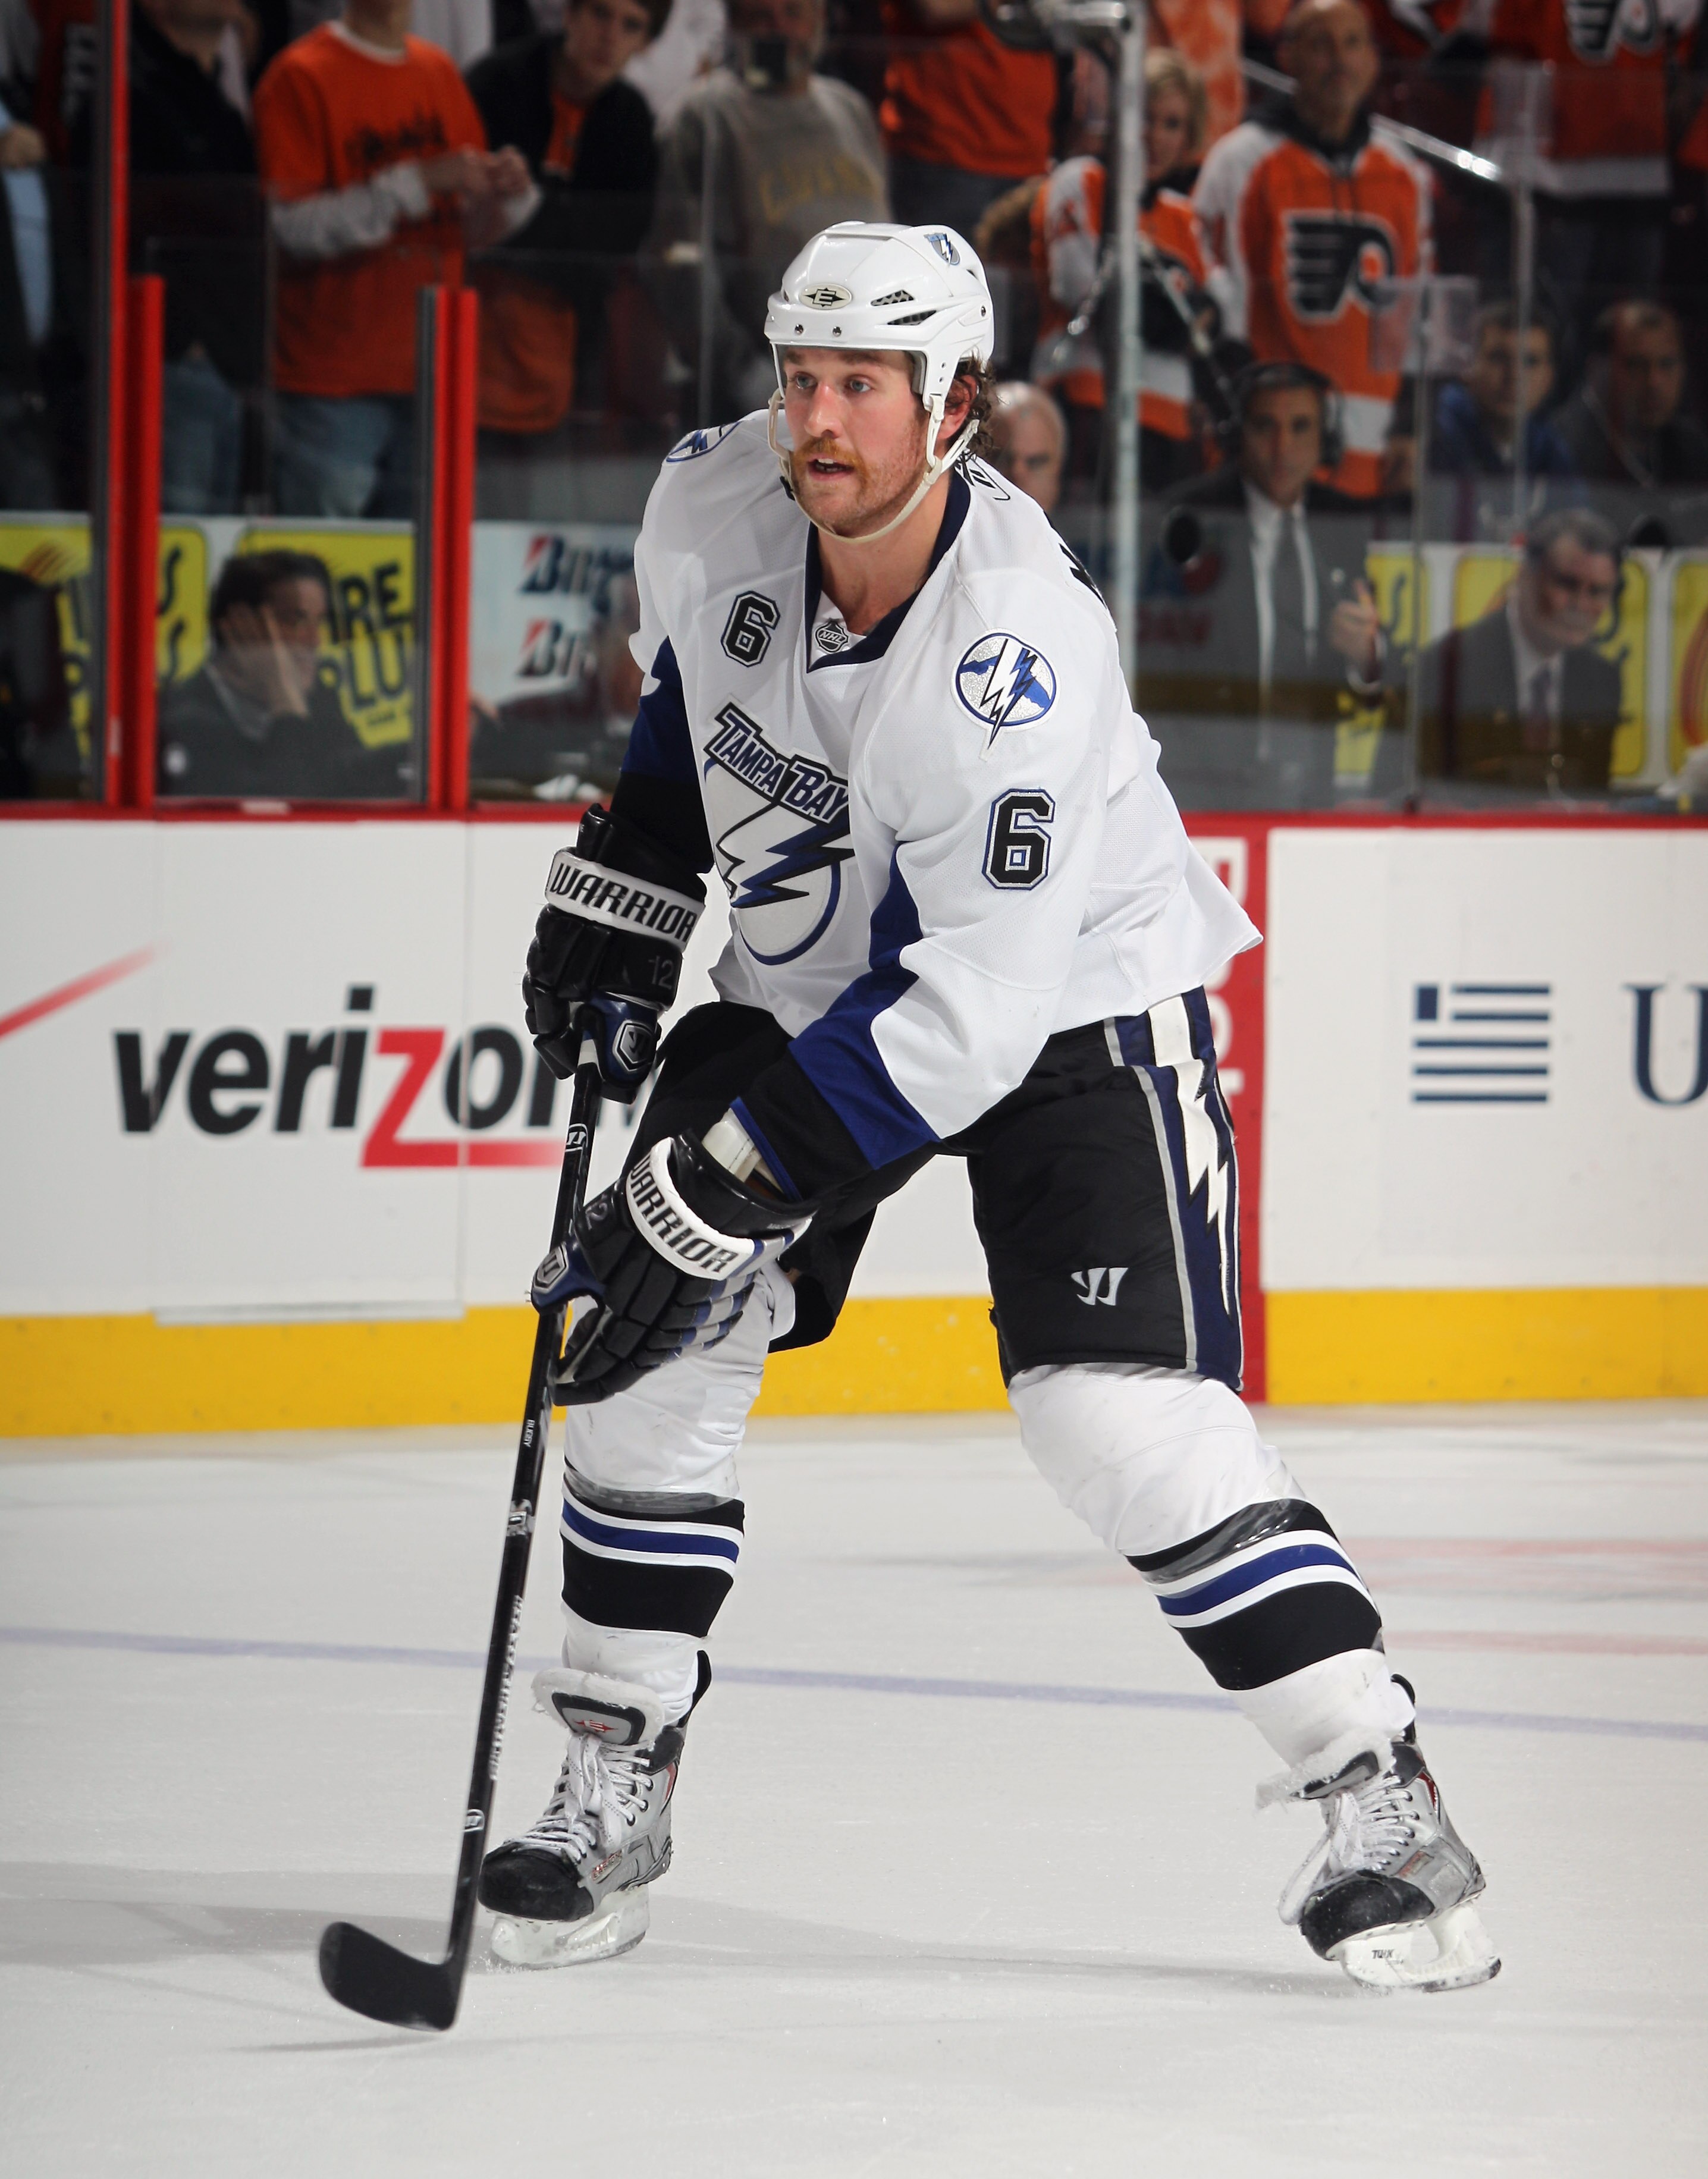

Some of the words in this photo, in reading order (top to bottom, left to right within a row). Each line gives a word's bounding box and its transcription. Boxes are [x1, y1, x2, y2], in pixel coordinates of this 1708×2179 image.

[720, 590, 781, 668] 6
[820, 630, 844, 643] NHL
[709, 708, 789, 797] TAMPA
[780, 760, 849, 824] BAY
[981, 788, 1056, 891] 6
[550, 862, 698, 943] WARRIOR
[648, 955, 674, 990] 12
[523, 1418, 535, 1448] BUGSY
